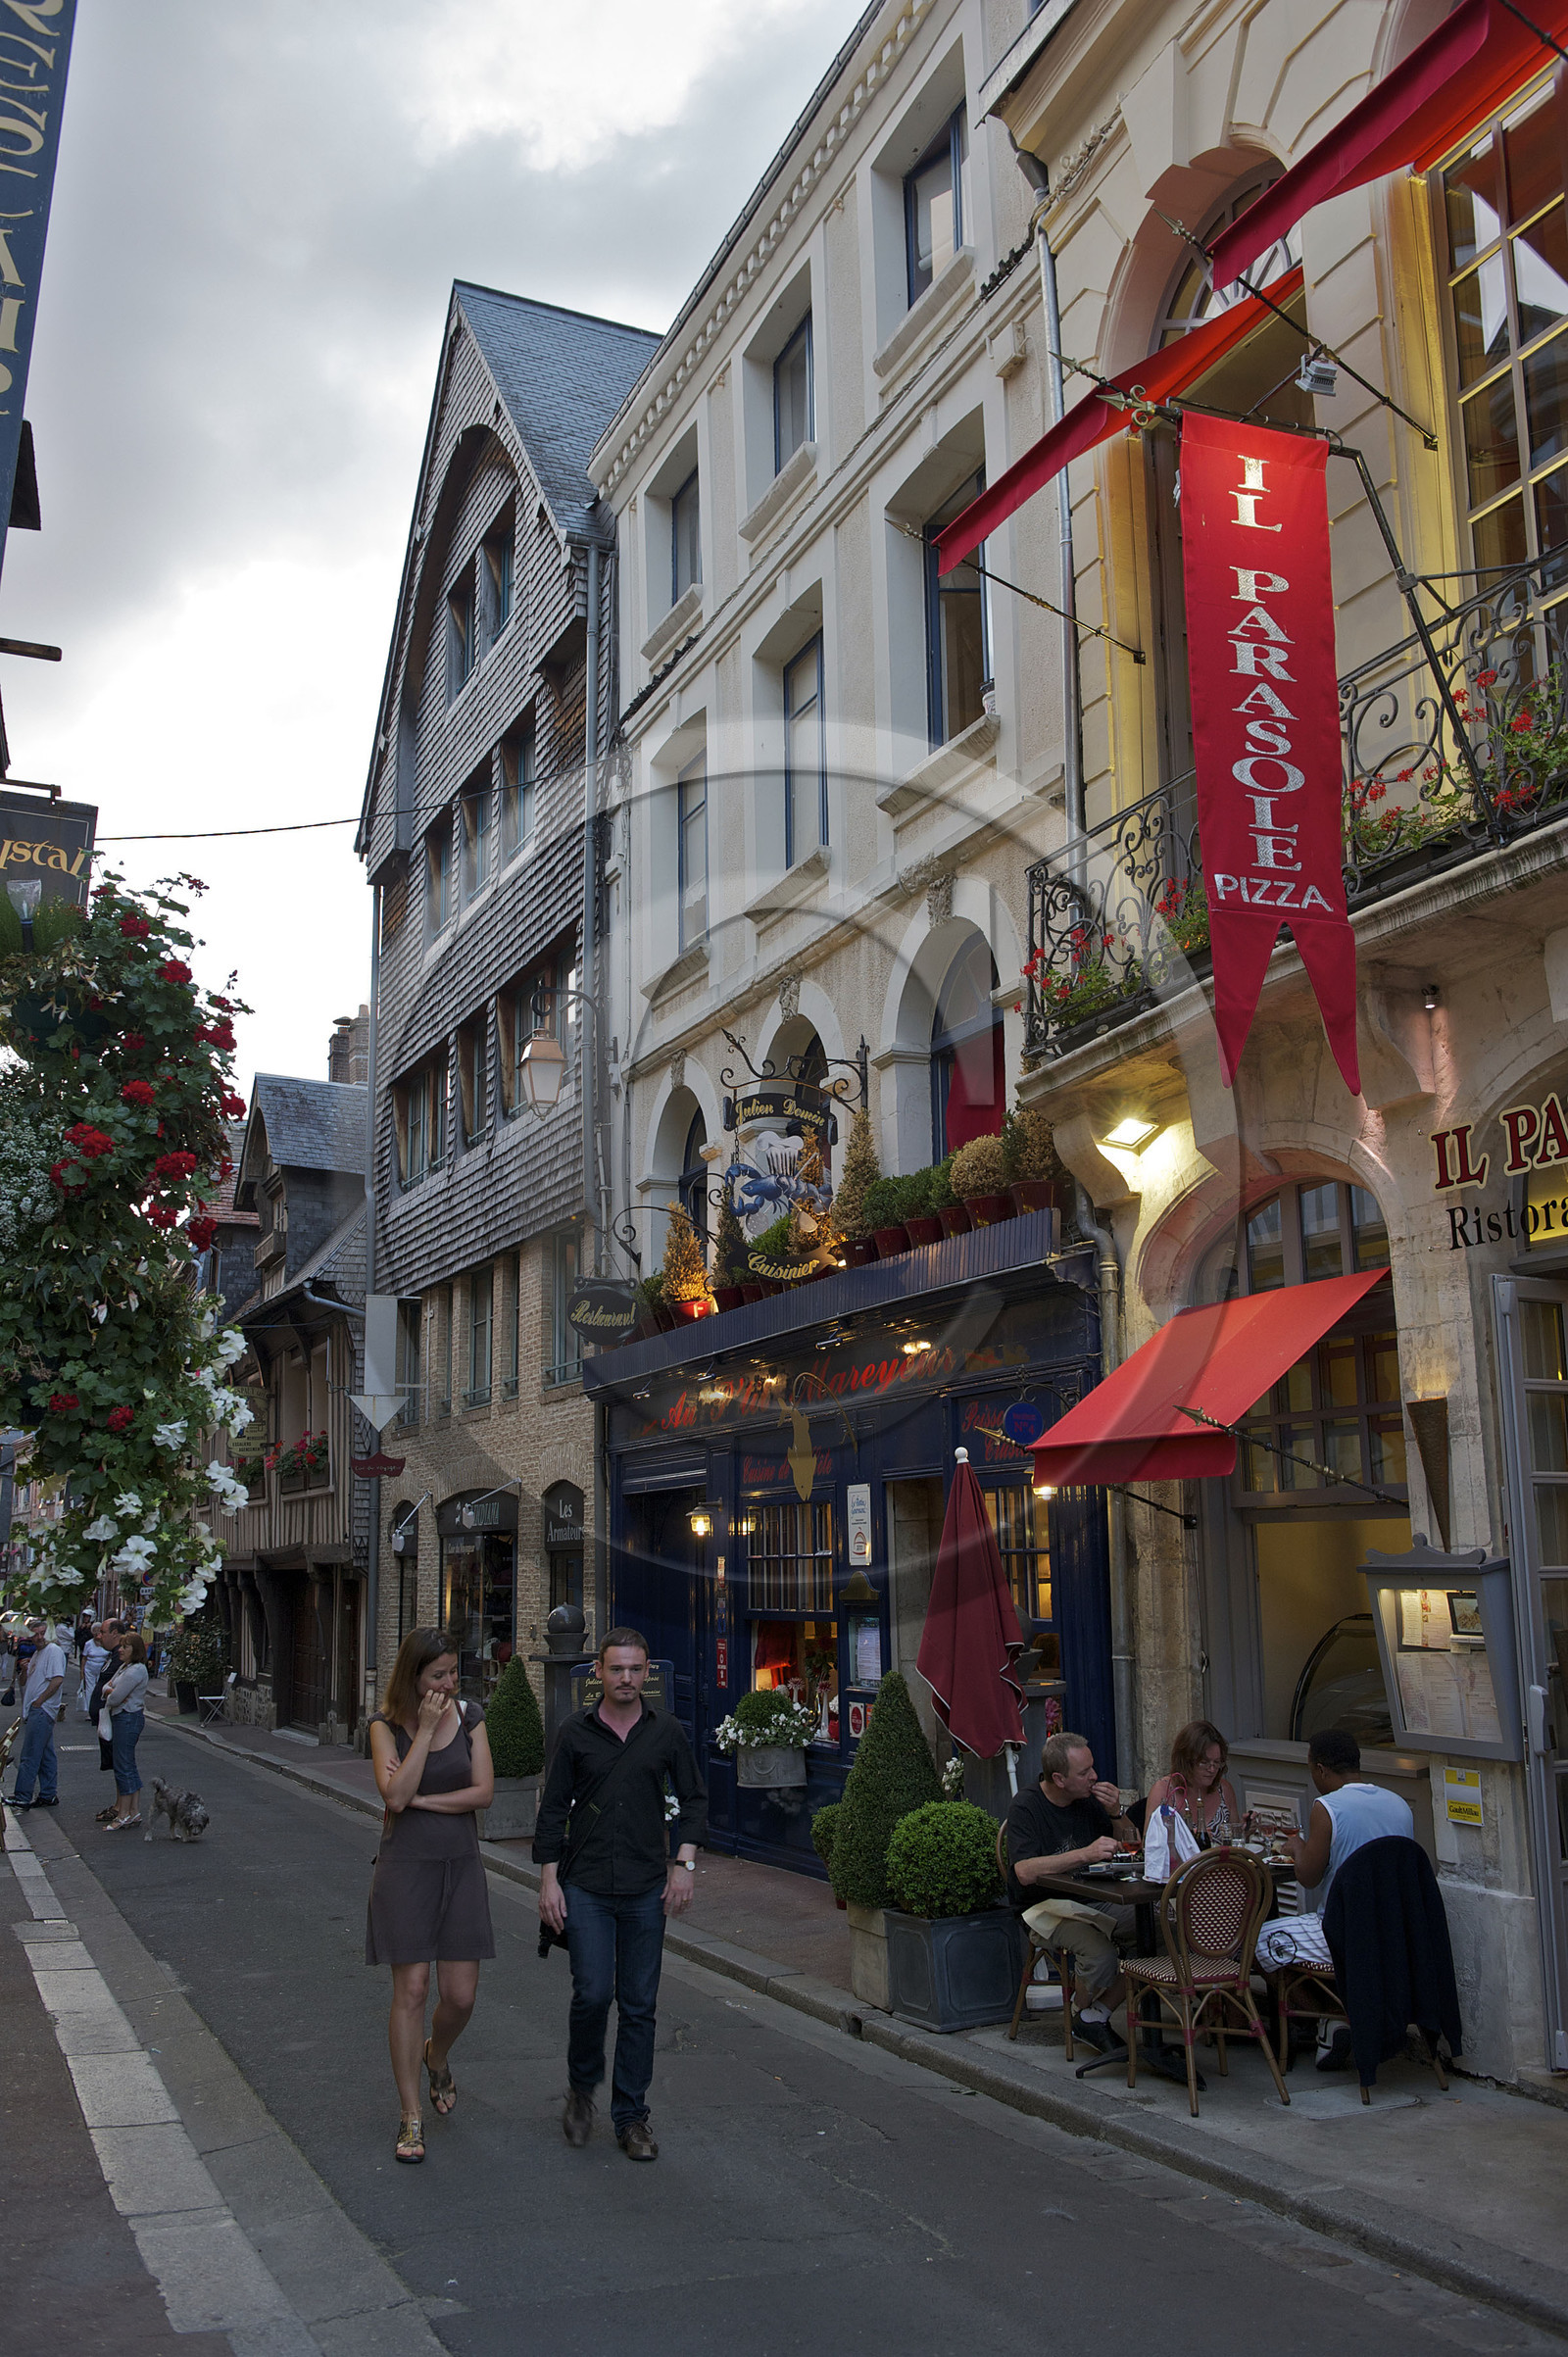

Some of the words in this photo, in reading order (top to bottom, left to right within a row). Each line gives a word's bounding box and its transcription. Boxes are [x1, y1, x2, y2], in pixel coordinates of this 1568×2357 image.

[1228, 454, 1284, 533] IL
[1227, 565, 1305, 872] PARASOLE
[1213, 872, 1334, 912] PIZZA
[735, 1101, 774, 1126] Julien
[1429, 1124, 1490, 1191] IL
[748, 1251, 820, 1282] Cuisinier
[559, 1498, 573, 1519] Les
[546, 1520, 585, 1543] Armateurs
